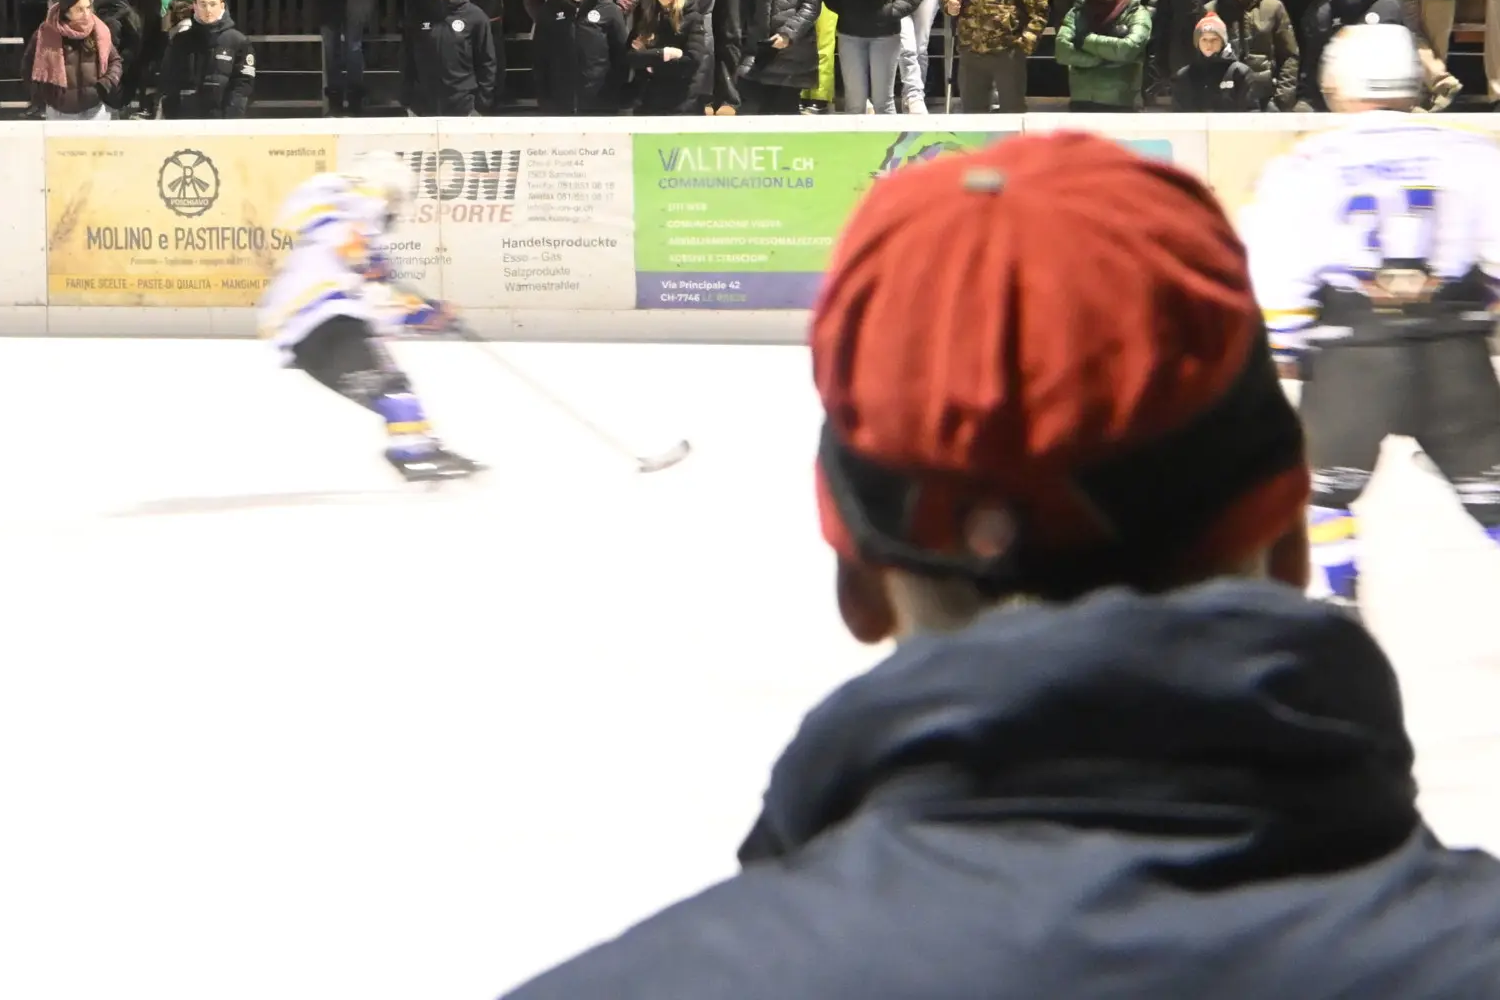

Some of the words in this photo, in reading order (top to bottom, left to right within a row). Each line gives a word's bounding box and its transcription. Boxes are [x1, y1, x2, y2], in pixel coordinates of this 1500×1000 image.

[578, 148, 599, 156] Chur
[601, 148, 615, 156] AG
[658, 176, 783, 189] COMMUNICATION
[787, 177, 814, 188] LAB
[86, 227, 153, 250] MOLINO
[158, 232, 169, 250] e
[174, 227, 265, 250] PASTIFICIO
[270, 227, 294, 250] SA
[502, 237, 618, 249] Handelsproduckte
[541, 251, 562, 262] Gas
[66, 278, 97, 290] FARINE
[98, 278, 127, 289] SCELTE
[661, 281, 678, 289] Via
[679, 280, 727, 291] Principale
[729, 281, 741, 289] 42
[660, 293, 701, 302] CH-7746
